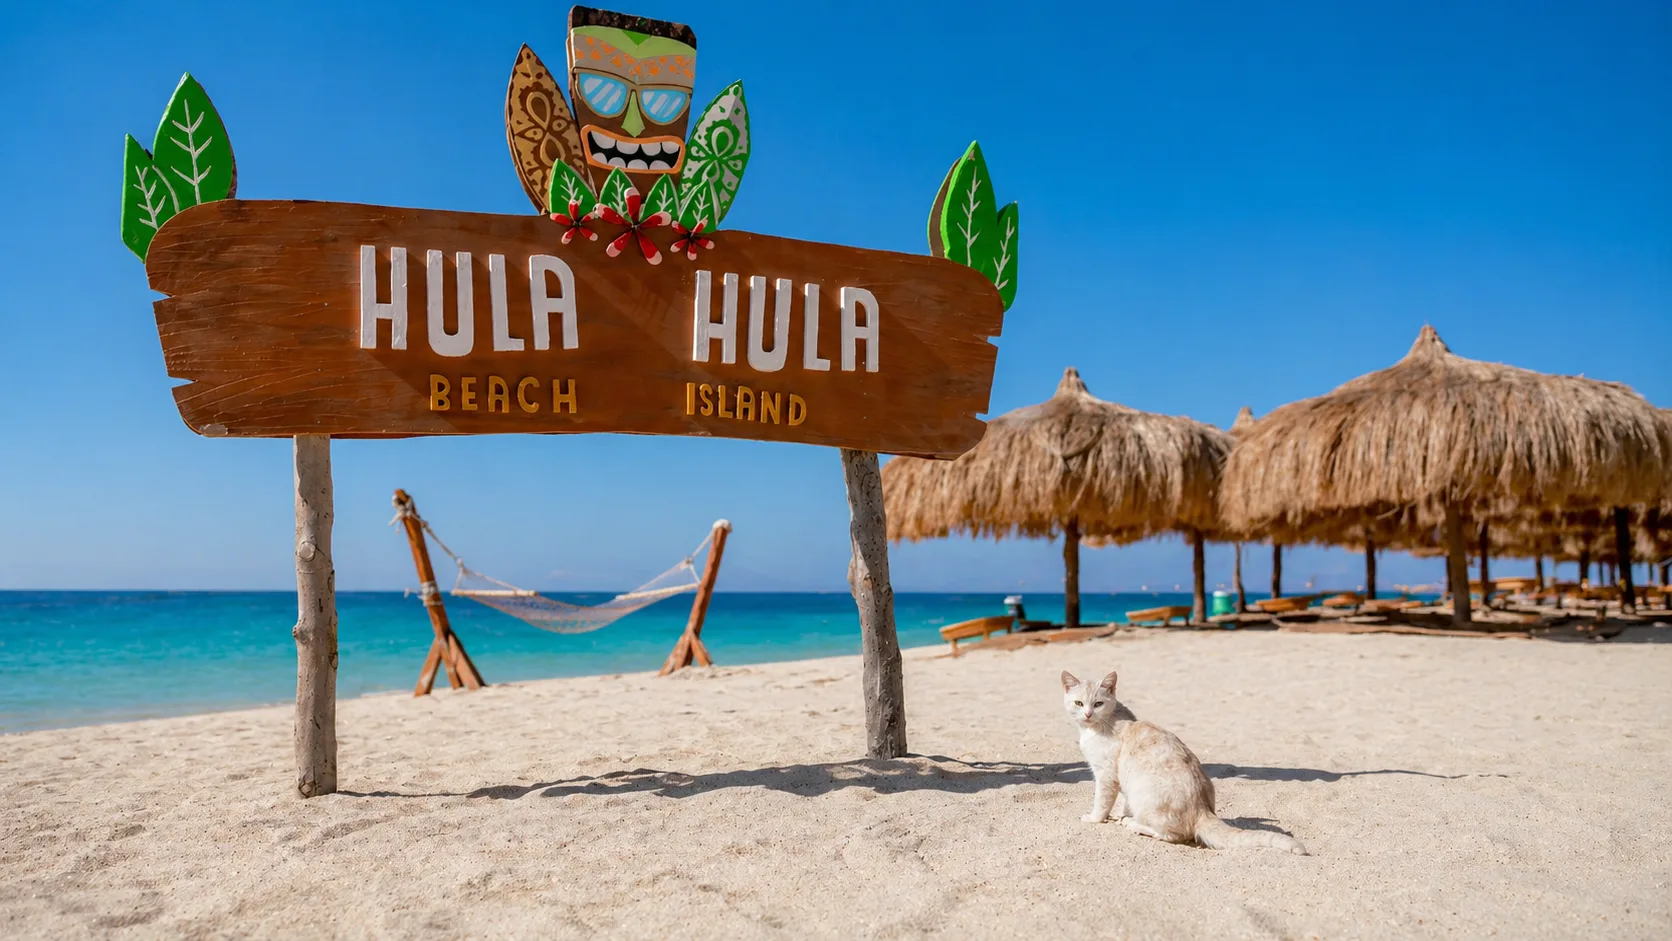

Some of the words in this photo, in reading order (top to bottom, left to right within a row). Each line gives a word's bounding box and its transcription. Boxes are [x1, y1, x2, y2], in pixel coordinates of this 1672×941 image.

[360, 245, 579, 357] HULA
[692, 269, 879, 372] HULA
[430, 374, 577, 413] BEACH
[686, 382, 807, 426] ISLAND
